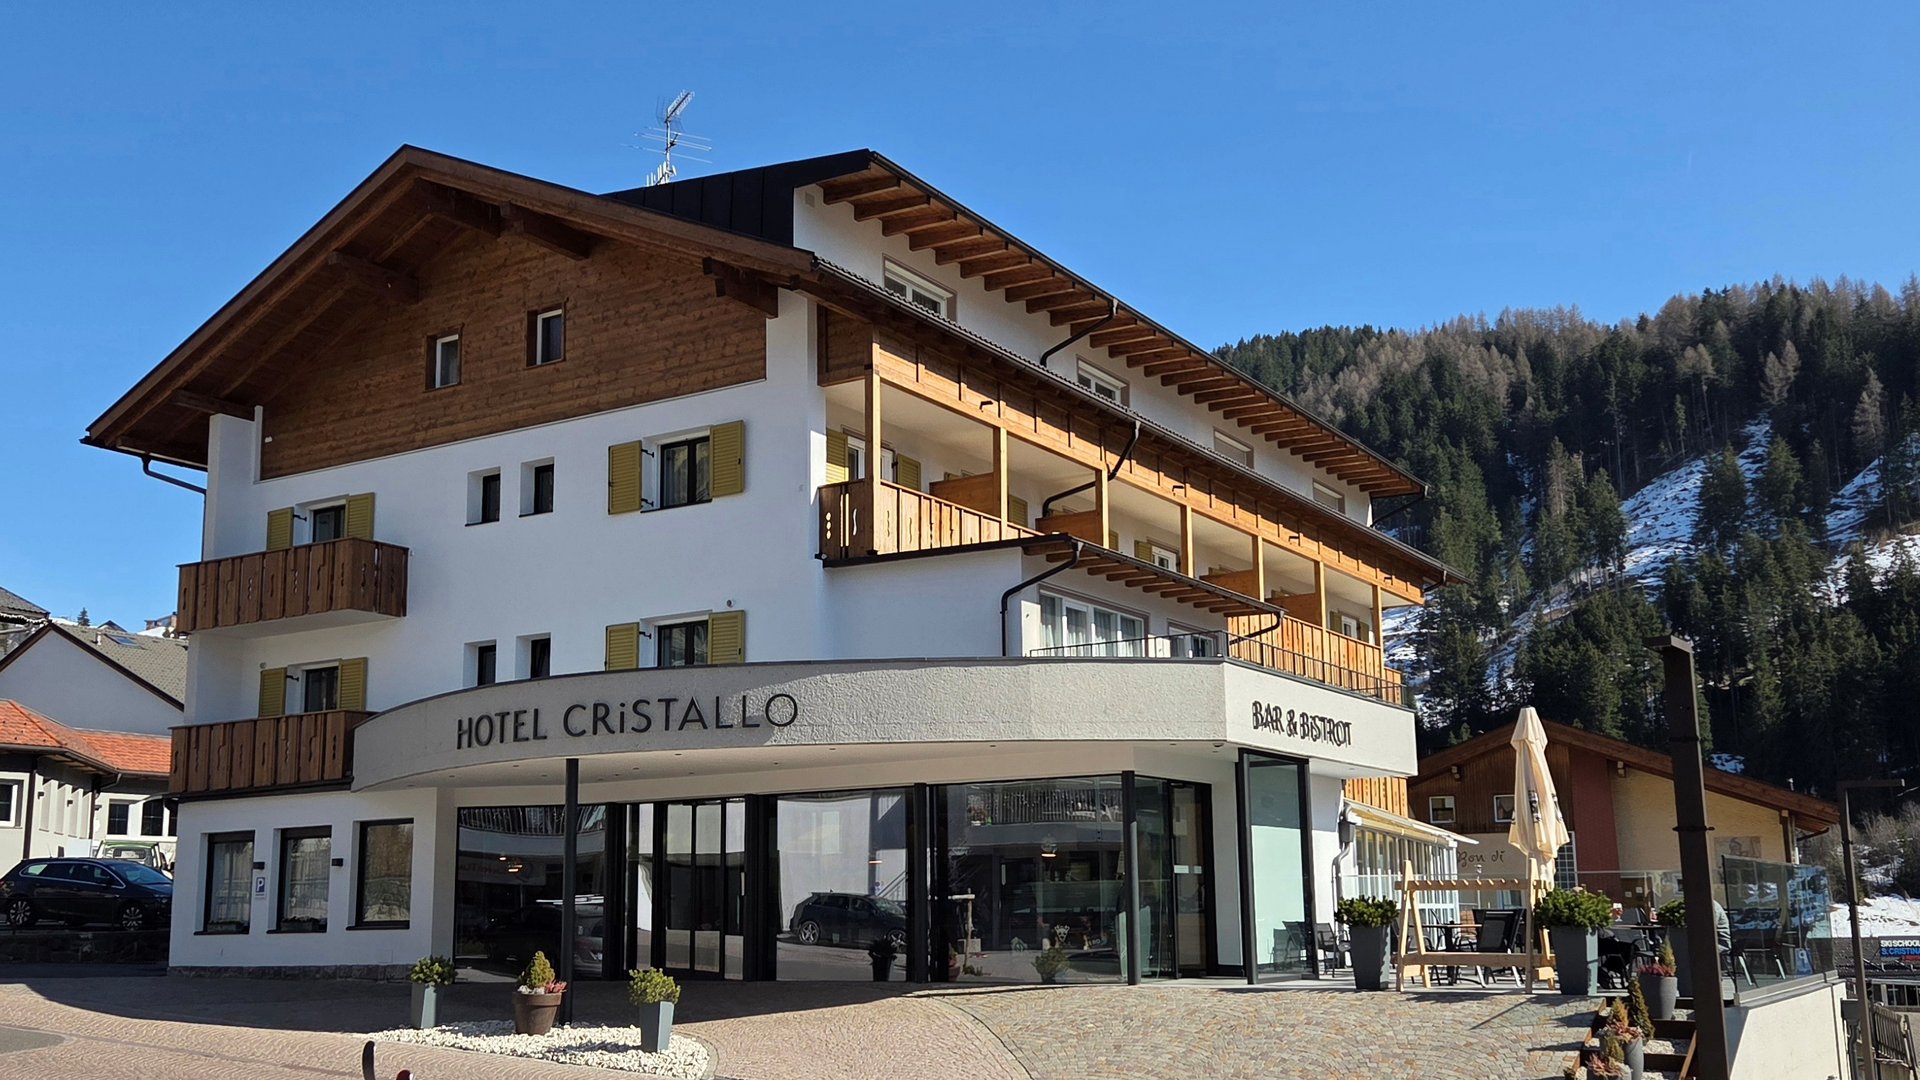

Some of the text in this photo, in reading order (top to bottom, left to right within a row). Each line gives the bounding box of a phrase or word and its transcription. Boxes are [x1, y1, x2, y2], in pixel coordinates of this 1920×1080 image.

[457, 708, 547, 750] HOTEL
[1252, 700, 1285, 735] BAR
[1286, 709, 1298, 738] &
[256, 878, 264, 891] P
